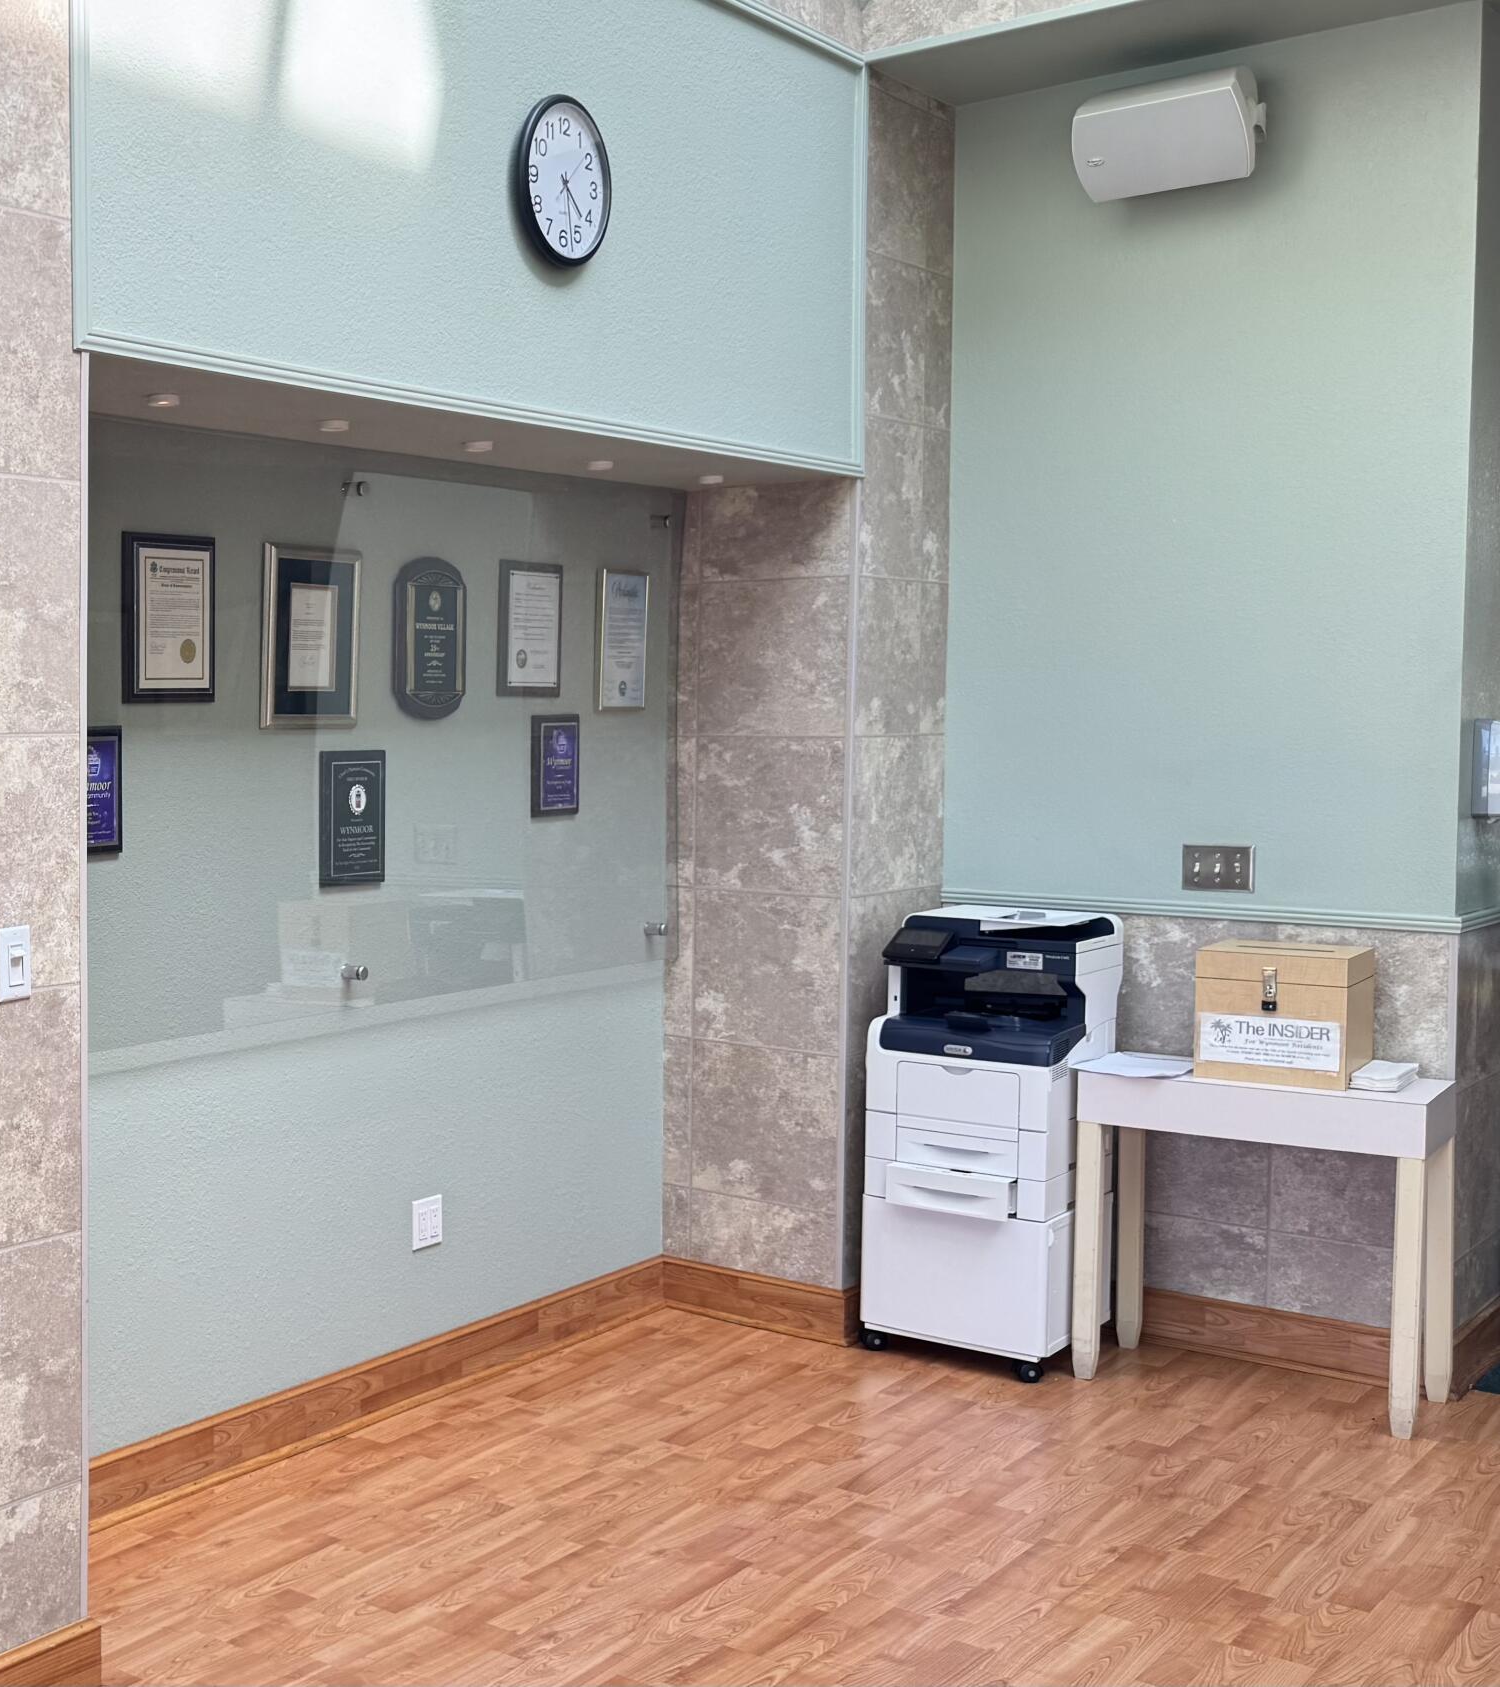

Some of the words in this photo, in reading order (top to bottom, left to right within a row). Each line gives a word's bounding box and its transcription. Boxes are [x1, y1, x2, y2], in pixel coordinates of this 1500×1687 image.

[545, 121, 554, 140] 11
[558, 117, 570, 136] 12
[534, 137, 547, 156] 10
[577, 132, 582, 149] 1
[584, 152, 593, 171] 2
[529, 164, 538, 183] 9
[589, 181, 598, 200] 3
[532, 195, 542, 213] 8
[545, 217, 553, 235] 7
[584, 209, 593, 227] 4
[558, 229, 568, 248] 6
[573, 225, 581, 243] 5
[87, 782, 112, 791] moor
[340, 825, 374, 835] WYNMOOR
[1235, 1020, 1265, 1036] The
[1268, 1023, 1330, 1042] INSIDER
